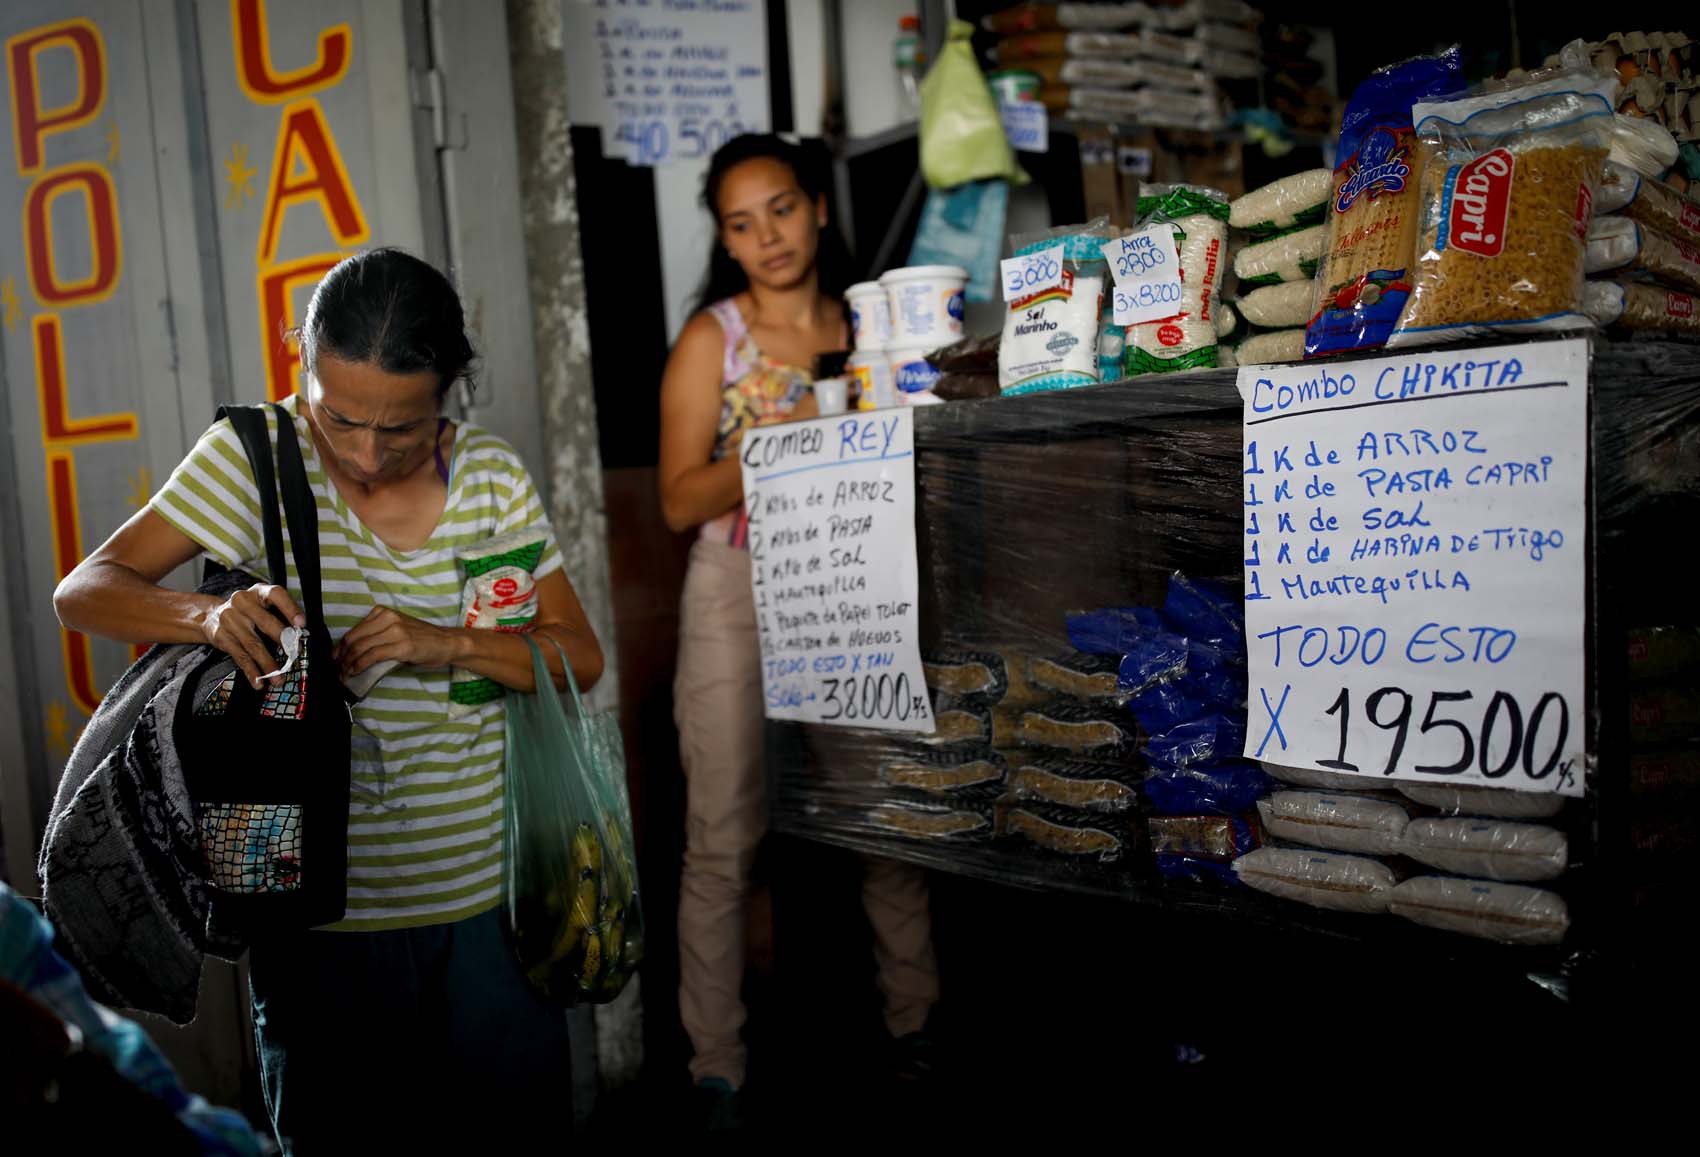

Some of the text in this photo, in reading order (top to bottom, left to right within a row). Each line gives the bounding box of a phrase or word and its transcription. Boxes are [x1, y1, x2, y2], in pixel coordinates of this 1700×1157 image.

[1454, 156, 1508, 244] Capri
[1007, 258, 1060, 292] 3000
[1014, 320, 1059, 338] Marinho
[1026, 307, 1046, 323] Sal
[743, 416, 899, 467] COMBO REY
[1244, 441, 1264, 474] 1
[1305, 441, 1341, 467] de
[1357, 429, 1488, 461] ARROZ
[748, 491, 761, 524] 2
[806, 486, 824, 506] de
[832, 480, 895, 508] ARROZ
[1244, 483, 1264, 506] 1
[1305, 475, 1336, 500] de
[1358, 468, 1453, 497] PASTA
[751, 531, 765, 560] 2
[828, 515, 873, 542] PASTA
[1245, 512, 1260, 535] 1
[1309, 507, 1340, 532] de
[1244, 543, 1260, 566] 1
[1306, 538, 1330, 564] de
[1451, 534, 1480, 553] DE
[1244, 571, 1271, 600] 1
[1257, 622, 1517, 667] TODO ESTO
[767, 655, 807, 679] TODO
[813, 654, 847, 672] ESTO
[820, 671, 911, 721] 38000
[1255, 684, 1292, 757] X
[1315, 686, 1569, 780] 19500
